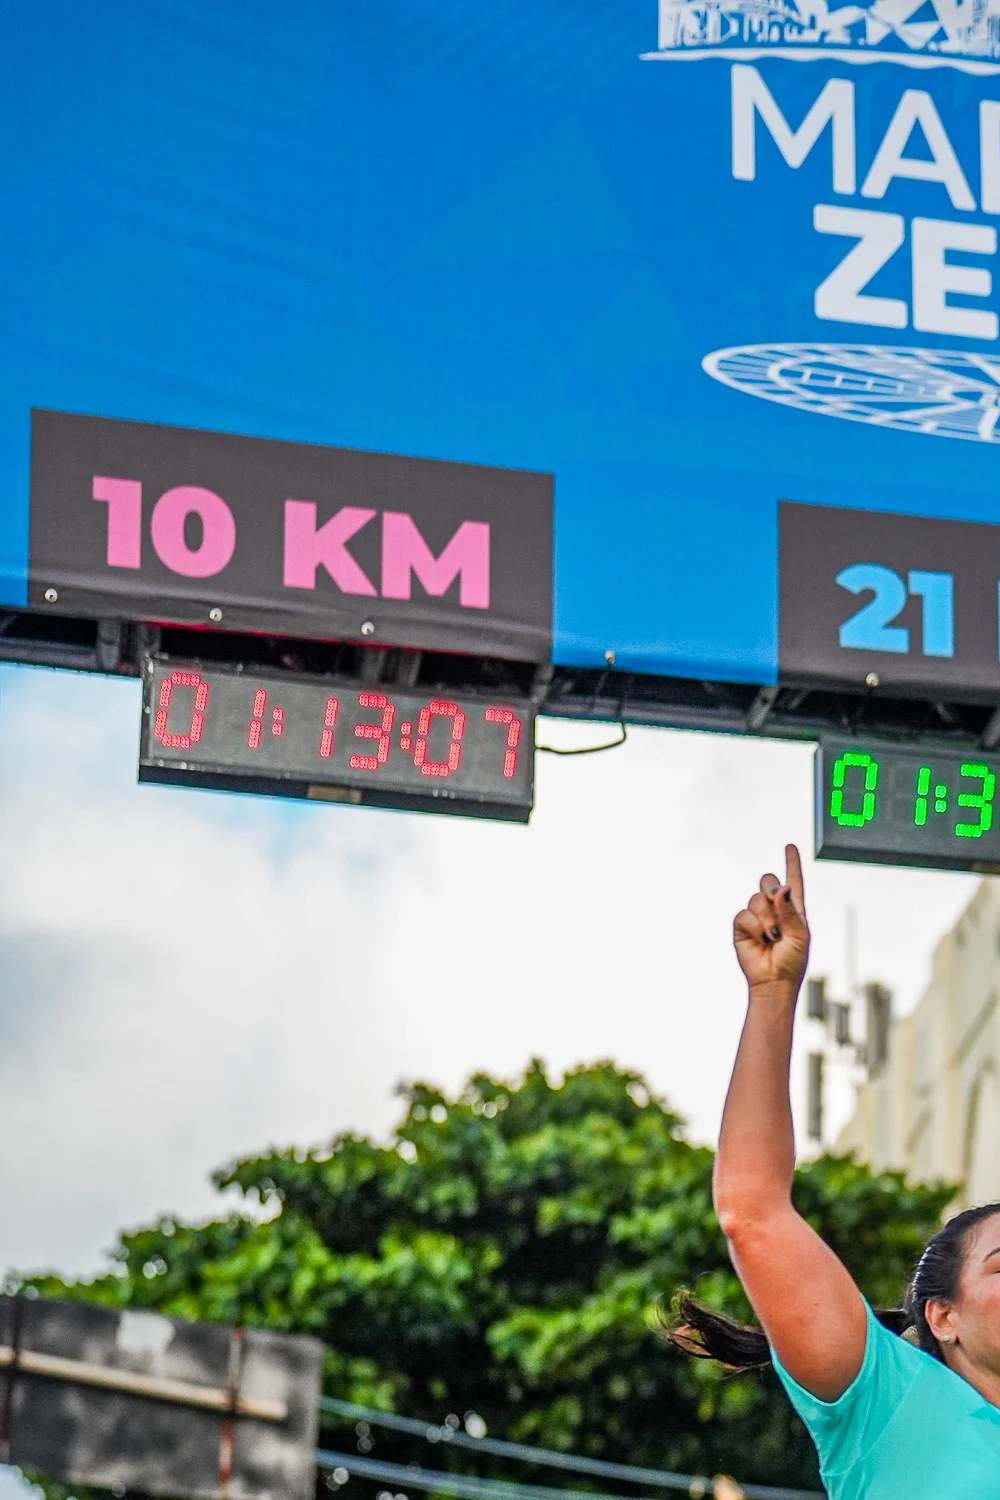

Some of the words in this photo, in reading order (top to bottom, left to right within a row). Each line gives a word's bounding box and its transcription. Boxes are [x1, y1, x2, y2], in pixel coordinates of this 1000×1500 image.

[92, 475, 236, 578] 10
[283, 499, 491, 609] KM
[835, 562, 954, 658] 21
